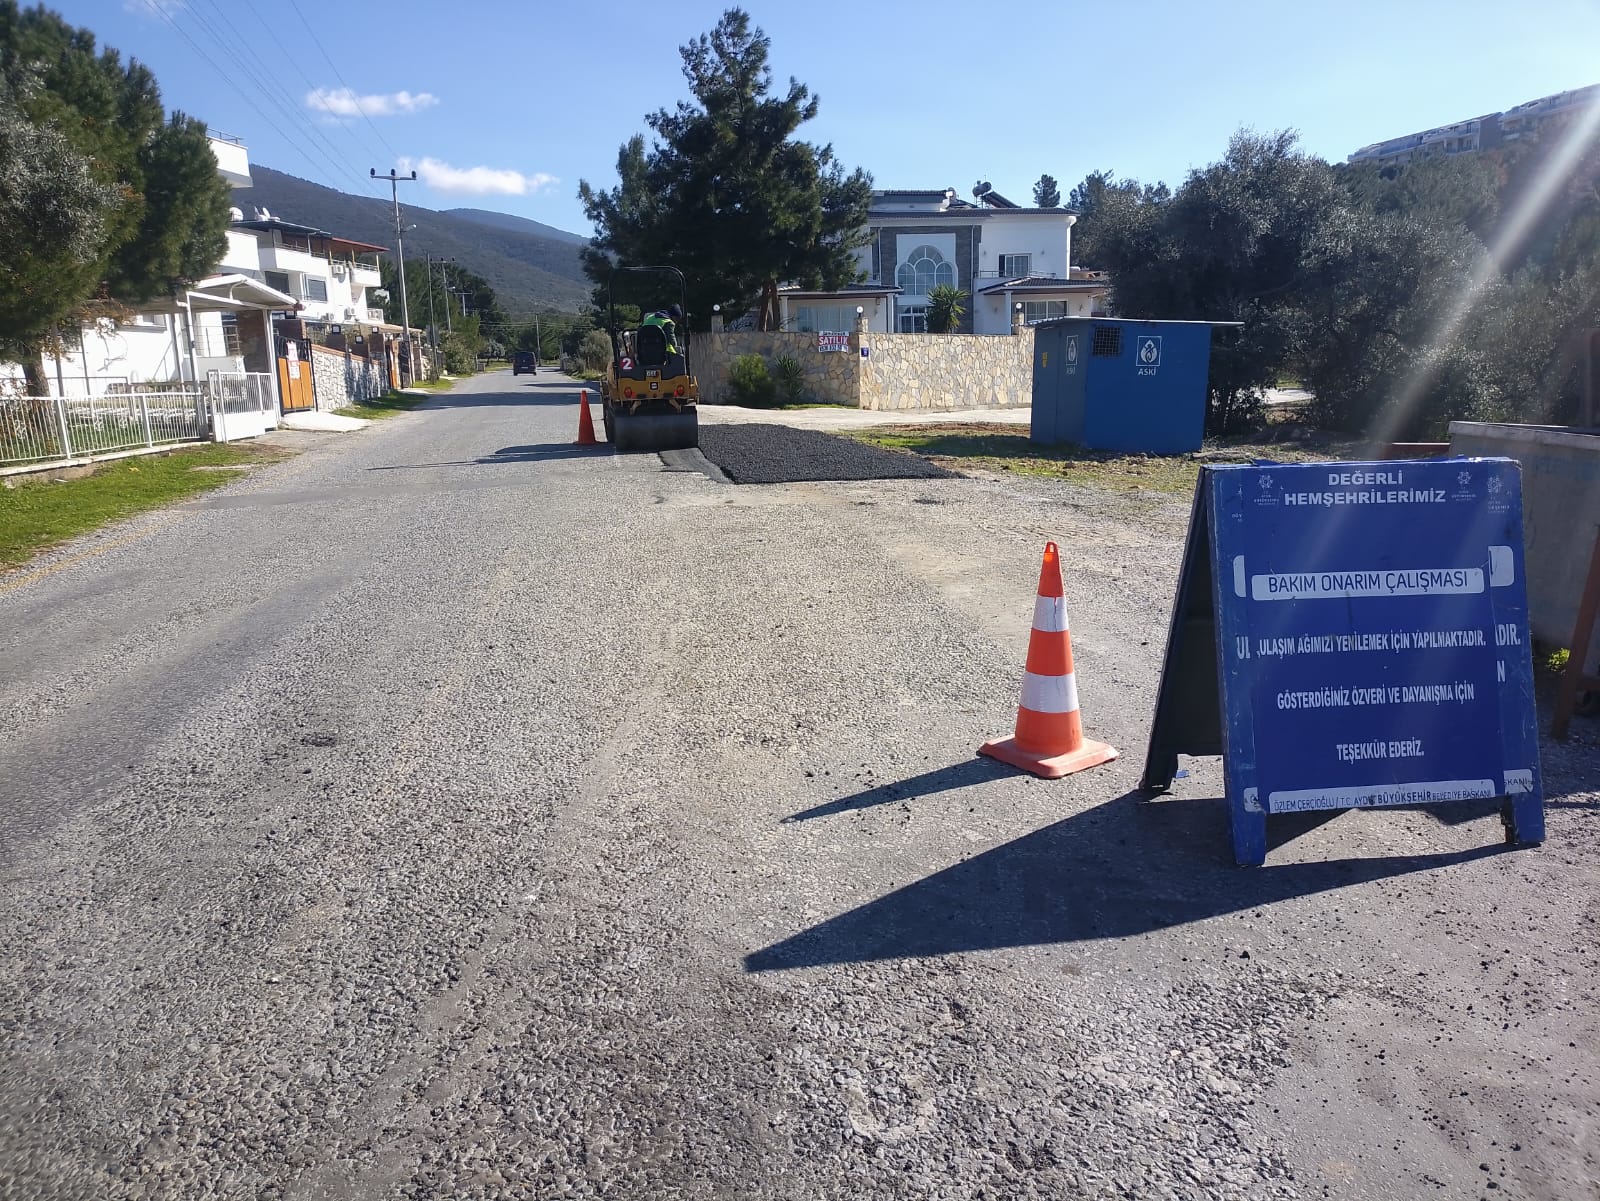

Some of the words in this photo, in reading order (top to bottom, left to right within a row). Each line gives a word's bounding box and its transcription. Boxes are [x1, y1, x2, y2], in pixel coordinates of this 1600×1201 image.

[819, 336, 849, 345] SATILIK
[622, 357, 633, 370] 2
[1328, 470, 1403, 487] DEĞERLİ
[1284, 487, 1447, 508] HEMŞEHRİLERİMİZ
[1268, 575, 1317, 593] BAKIM
[1321, 572, 1381, 592] ONARIM
[1385, 570, 1468, 594] ÇALIŞMASI
[1297, 633, 1334, 654] AĞIMIZI
[1336, 630, 1389, 652] YENİLEMEK
[1390, 628, 1410, 653] İÇİN
[1412, 629, 1487, 649] YAPILMAKTADIR.
[1277, 686, 1350, 710] GÖSTERDİĞİNİZ
[1351, 683, 1386, 706] ÖZVERİ
[1388, 687, 1401, 704] VE
[1402, 684, 1453, 706] DAYANIŞMA
[1454, 680, 1475, 704] İÇİN
[1336, 739, 1388, 765] TEŞEKKÜR
[1388, 737, 1425, 758] EDERİZ.
